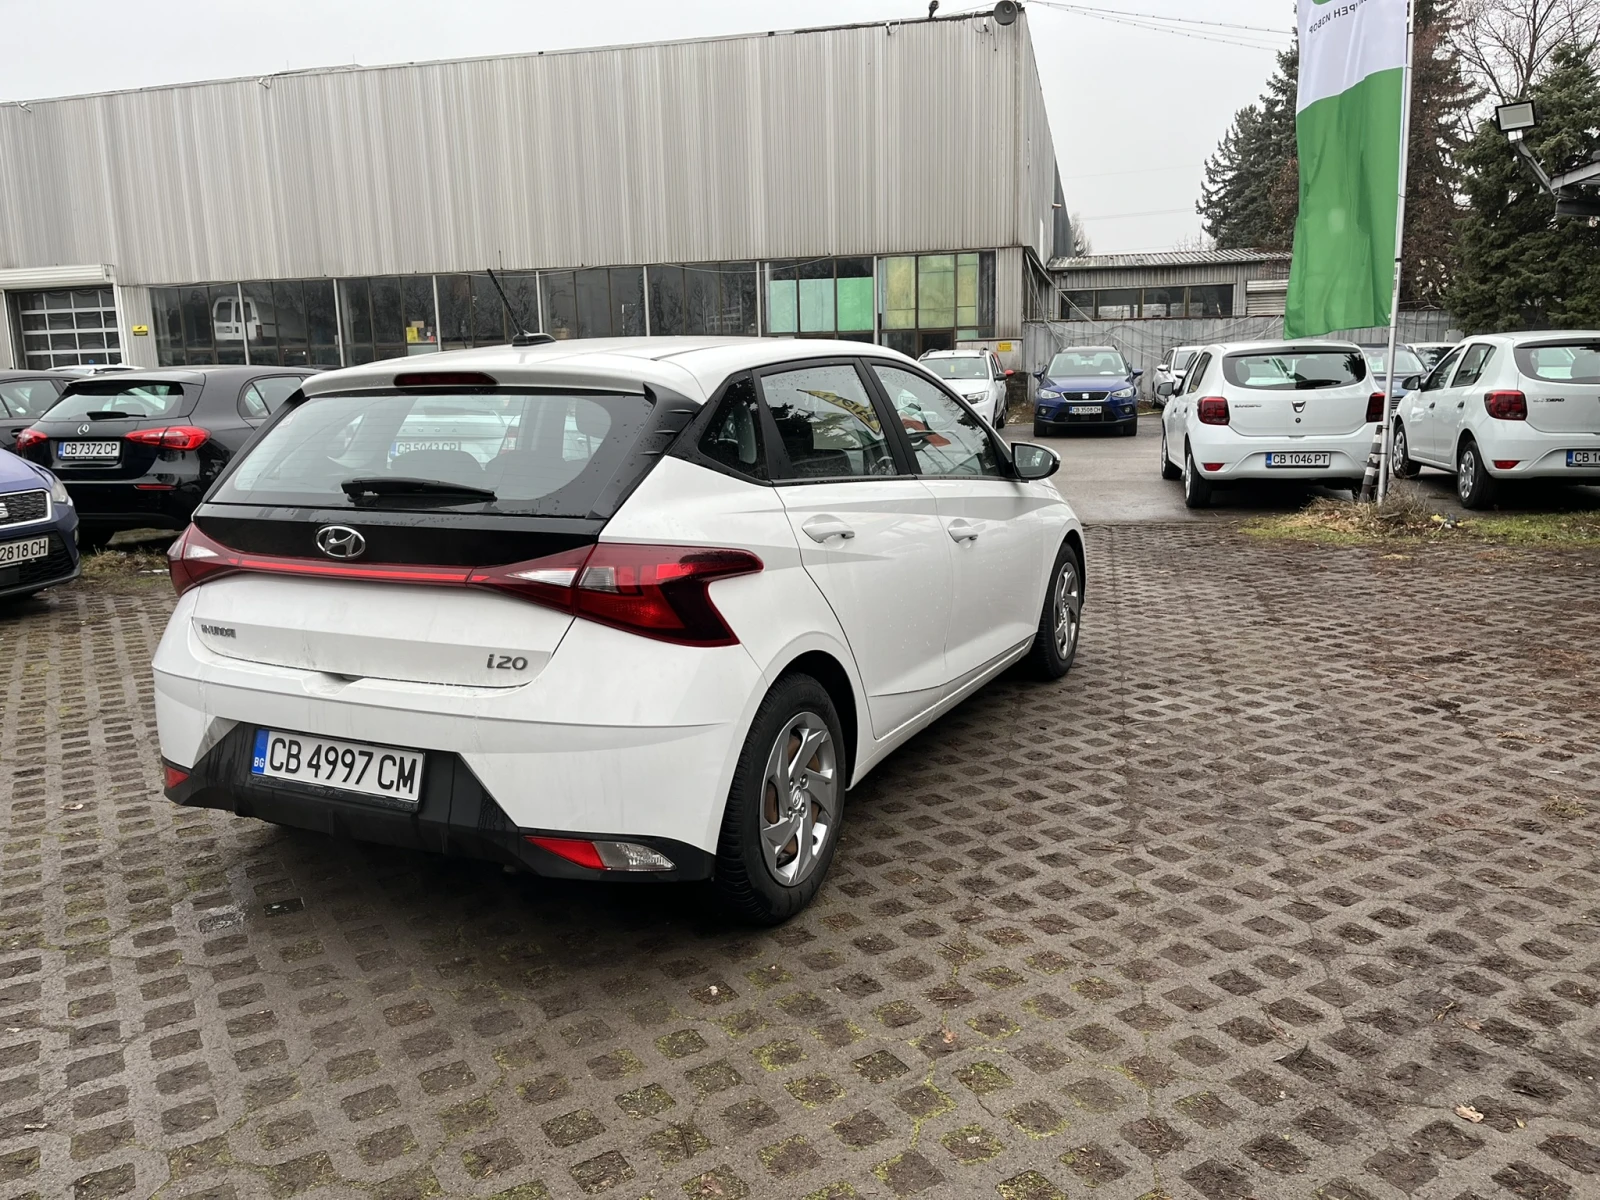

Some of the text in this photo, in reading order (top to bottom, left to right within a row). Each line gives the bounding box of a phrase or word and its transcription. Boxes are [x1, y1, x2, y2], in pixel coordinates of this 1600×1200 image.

[64, 443, 117, 455] CB 7372 CP
[1273, 455, 1328, 464] CB 1046 PT
[1575, 452, 1589, 463] CB
[0, 539, 46, 560] 2818 CH
[486, 653, 528, 670] i20
[253, 757, 265, 768] BG
[269, 737, 417, 794] CB 4997 CM
